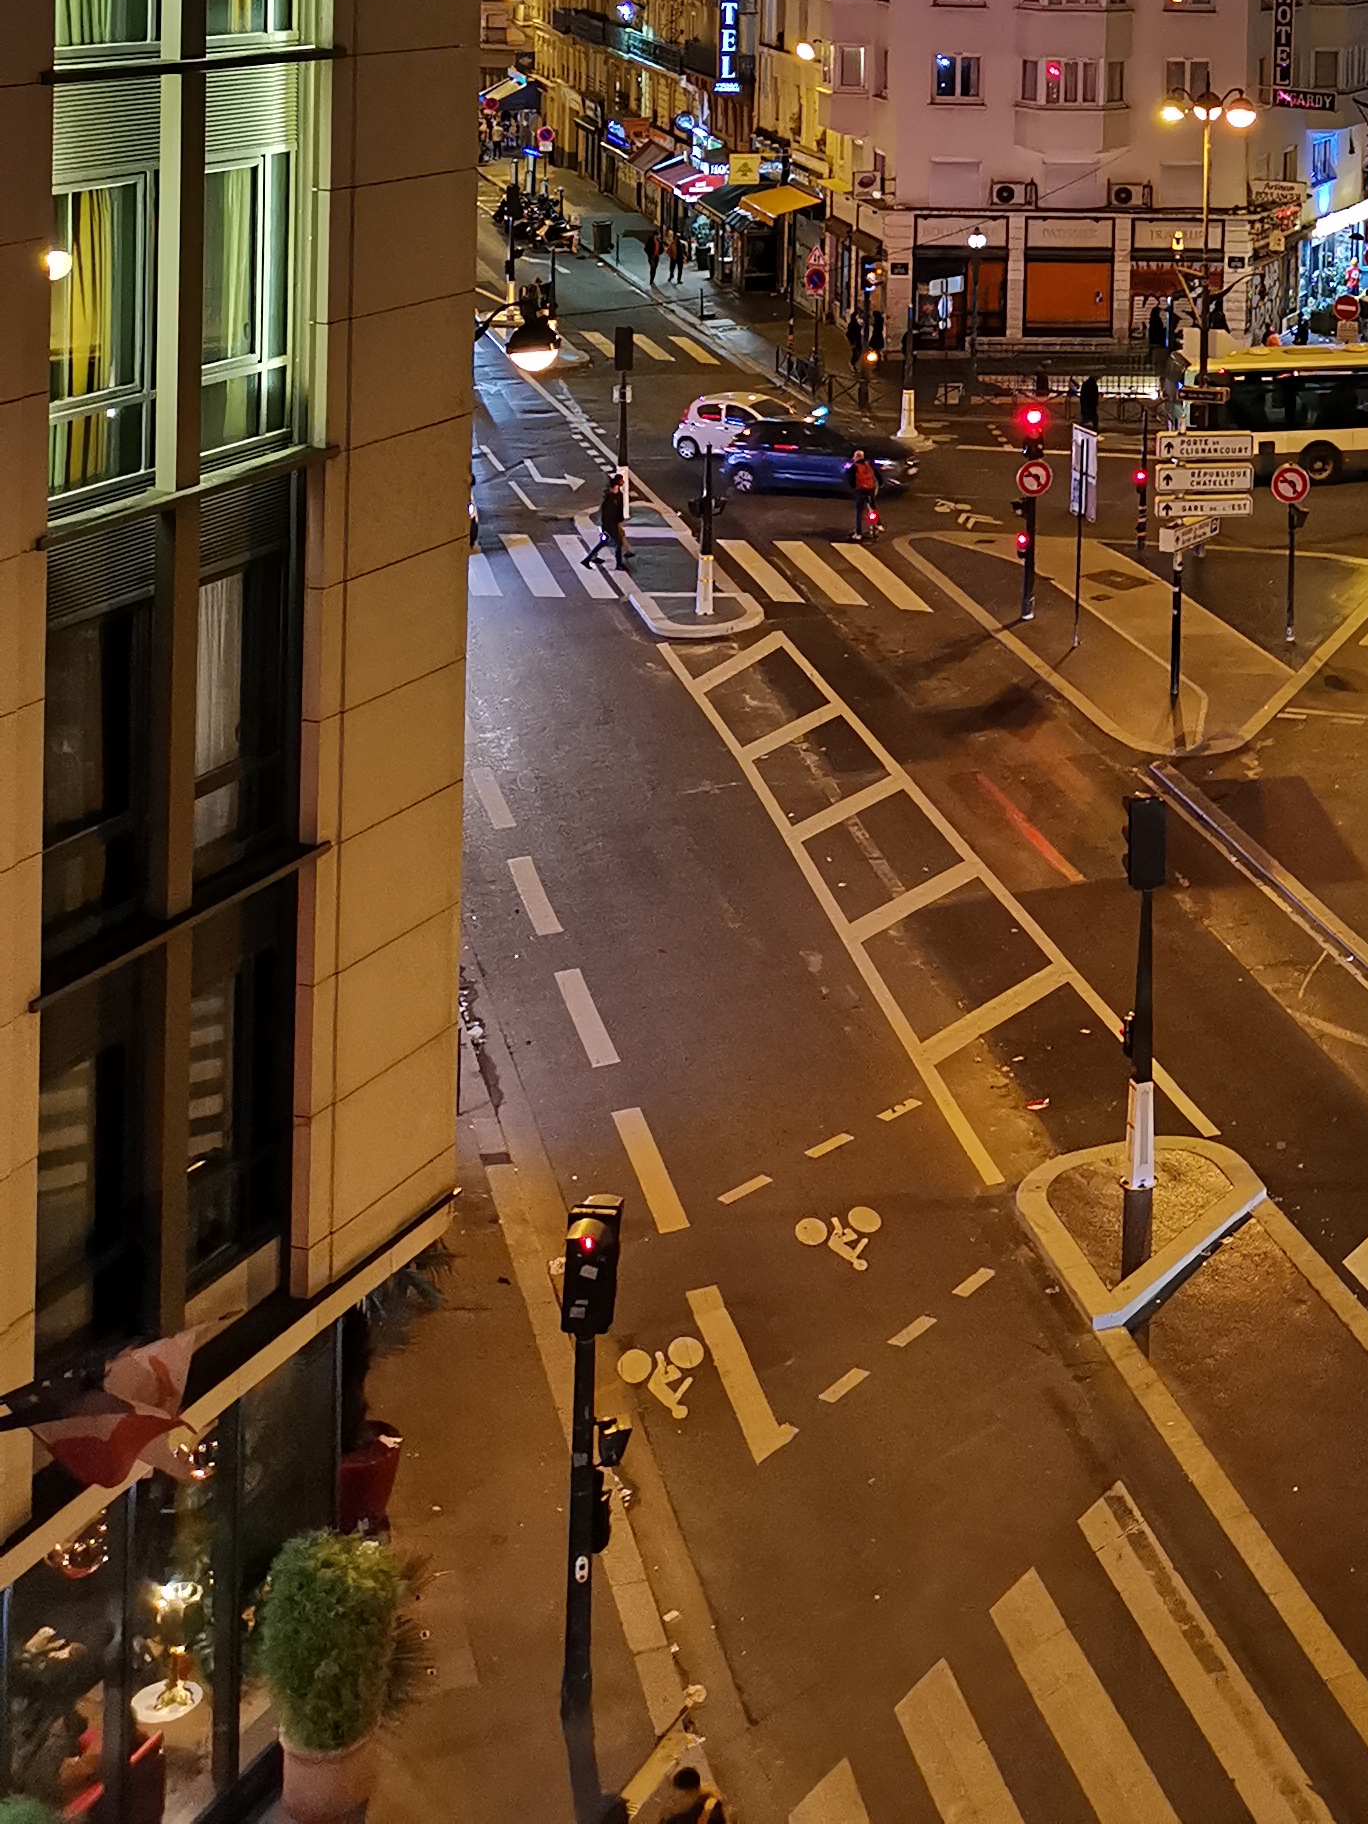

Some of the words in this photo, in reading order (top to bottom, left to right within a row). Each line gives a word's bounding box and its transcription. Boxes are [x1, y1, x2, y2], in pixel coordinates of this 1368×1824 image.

[1180, 438, 1209, 446] PORTE
[1180, 447, 1249, 456] CLIGNANCOURT
[1181, 504, 1205, 512] GARE
